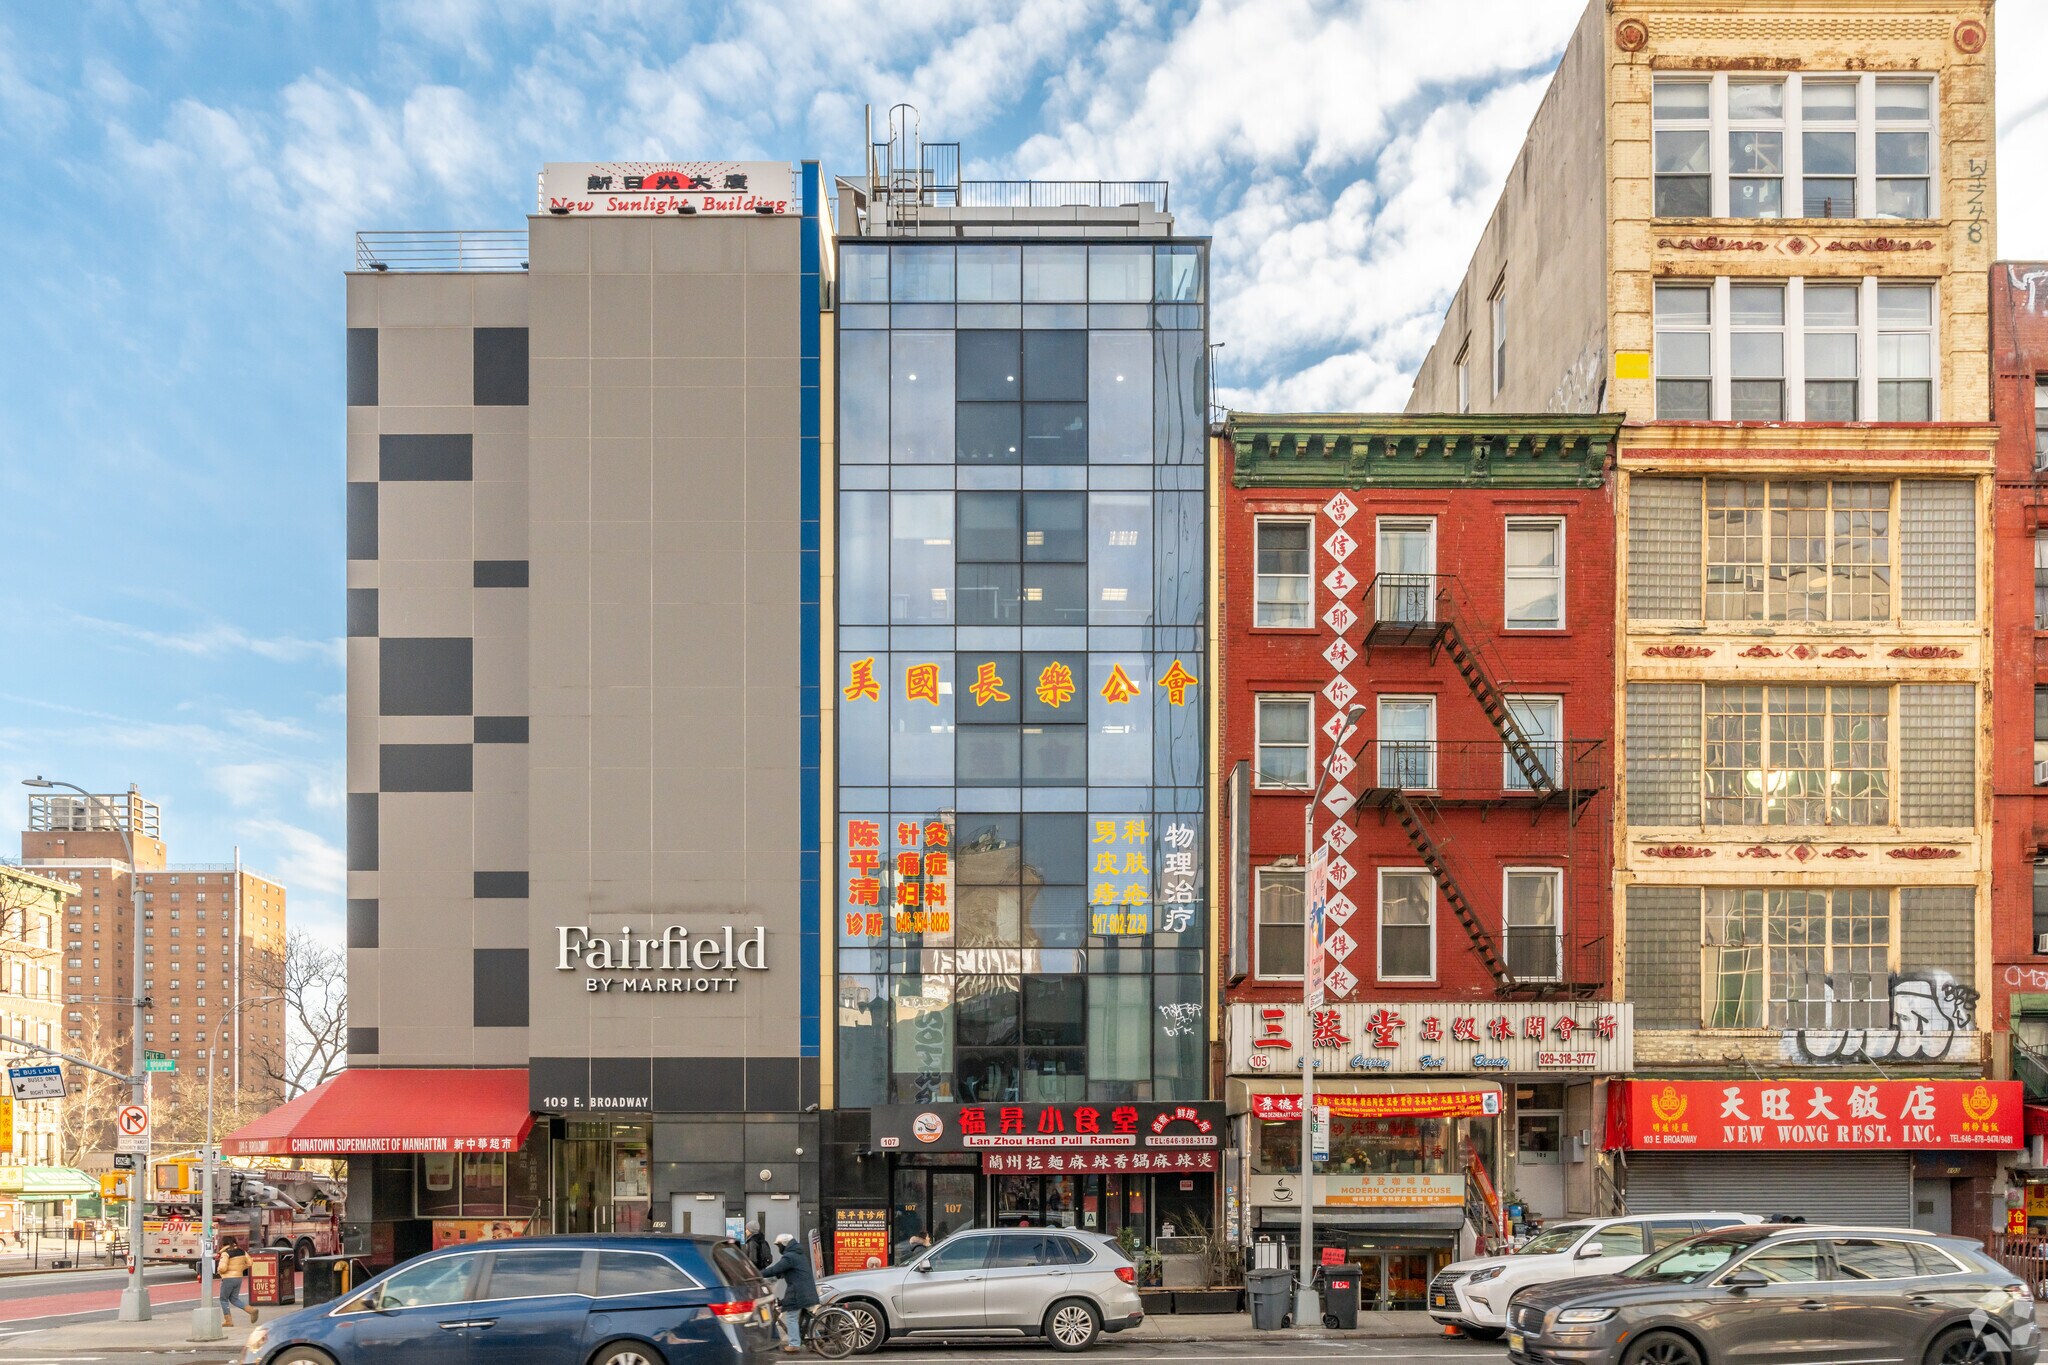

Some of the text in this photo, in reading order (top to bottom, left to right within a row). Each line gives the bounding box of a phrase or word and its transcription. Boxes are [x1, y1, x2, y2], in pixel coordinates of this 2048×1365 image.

[550, 195, 787, 214] New Sunlight Building
[843, 656, 1198, 708] 美國長樂公會
[896, 822, 948, 846] 针灸
[1092, 819, 1149, 845] 男科
[896, 852, 949, 876] 痛症
[1092, 852, 1149, 876] 皮肤
[1163, 823, 1195, 933] 物理治疗
[896, 882, 949, 906] 妇科
[1092, 883, 1149, 907] 痔疮
[846, 912, 883, 937] 诊所
[896, 912, 950, 933] 646-354-8828
[1092, 913, 1147, 935] 917-602-2229
[555, 925, 769, 970] Fairfield
[586, 978, 738, 992] BY MARRIOTT
[1253, 1008, 1407, 1050] 三蒸堂
[1251, 1055, 1267, 1067] 105
[1350, 1054, 1392, 1070] Cupping
[1419, 1055, 1445, 1069] Foot
[1473, 1054, 1510, 1069] Beauty
[1539, 1053, 1596, 1065] 929-318-3777
[543, 1096, 649, 1108] 109 E. BROADWAY
[1720, 1086, 1937, 1121] 天旺大飯店
[958, 1105, 1139, 1135] 福昇小食堂
[453, 1137, 512, 1150] 新中華超市
[969, 1136, 1130, 1145] Lan Zhou Hand Pull Ramen
[1149, 1137, 1214, 1145] TEL:646-998-3175
[1643, 1135, 1697, 1144] 103 E. BROADWAY
[1722, 1125, 1941, 1143] NEW WONG REST. INC.
[292, 1137, 447, 1152] CHINATOWN SUPERMARKET OF MANHATTAN
[117, 1157, 127, 1165] ONE
[267, 1171, 282, 1179] TOWER
[283, 1172, 299, 1180] LADDER
[945, 1204, 962, 1213] 107
[161, 1223, 191, 1231] FDNY
[1087, 1214, 1094, 1223] A
